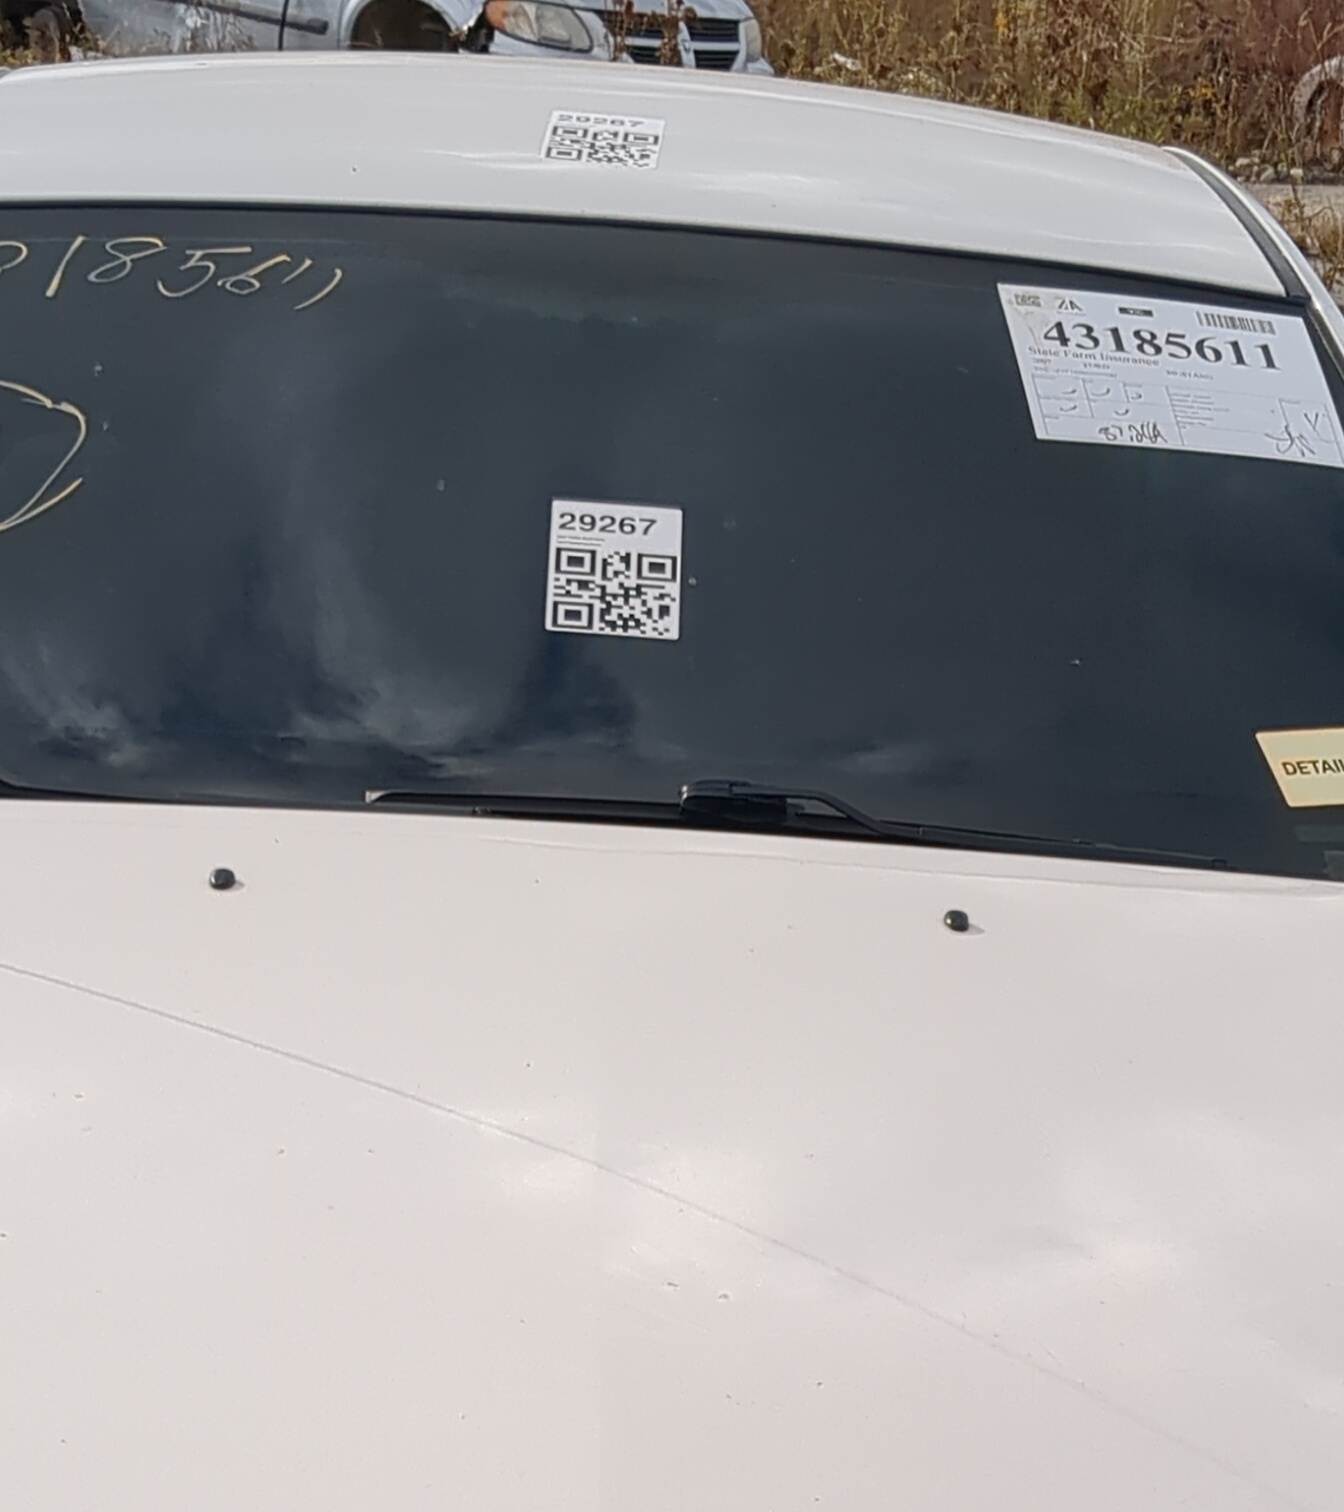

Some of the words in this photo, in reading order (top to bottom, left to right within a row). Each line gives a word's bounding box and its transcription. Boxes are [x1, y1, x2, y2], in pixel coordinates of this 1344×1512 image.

[1043, 320, 1282, 371] 43185611
[1064, 350, 1097, 360] Farm
[1100, 353, 1160, 367] Insurance
[558, 512, 658, 536] 29267
